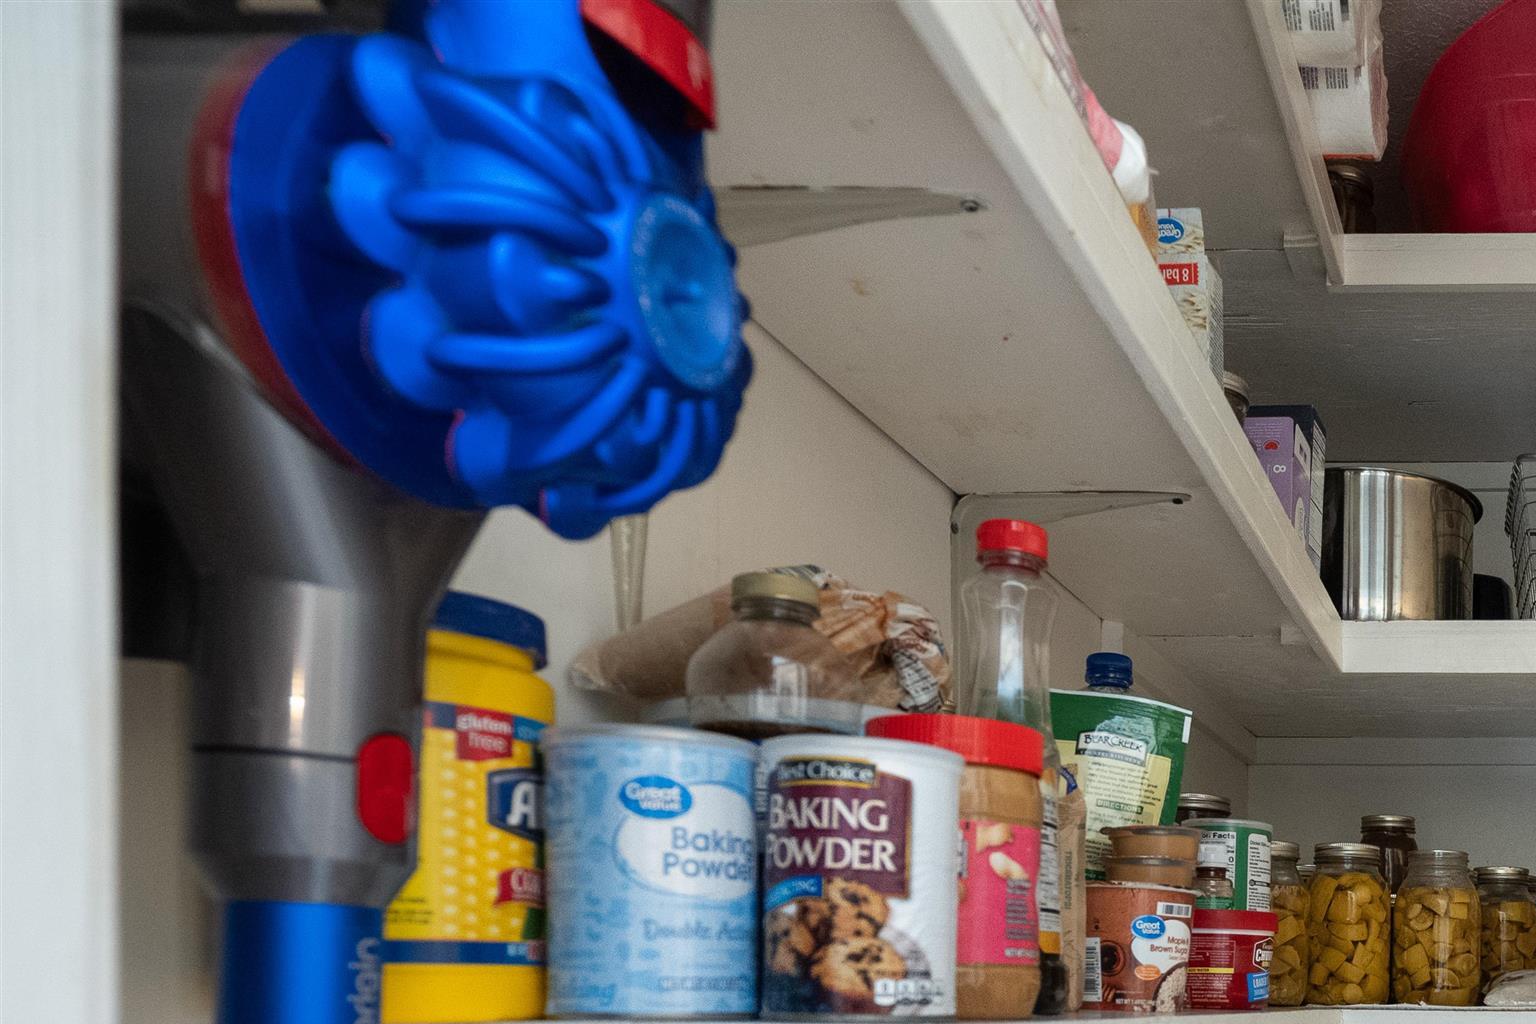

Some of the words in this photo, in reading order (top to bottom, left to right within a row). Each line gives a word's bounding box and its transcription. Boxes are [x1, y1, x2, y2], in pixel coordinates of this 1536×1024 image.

[1182, 268, 1190, 282] 8
[456, 711, 513, 735] gluten
[467, 731, 507, 753] free
[806, 760, 875, 782] Choice
[625, 781, 681, 802] Great
[769, 793, 889, 833] BAKING
[1213, 831, 1235, 839] Facts
[1135, 920, 1161, 930] Great
[1150, 944, 1174, 953] Brown
